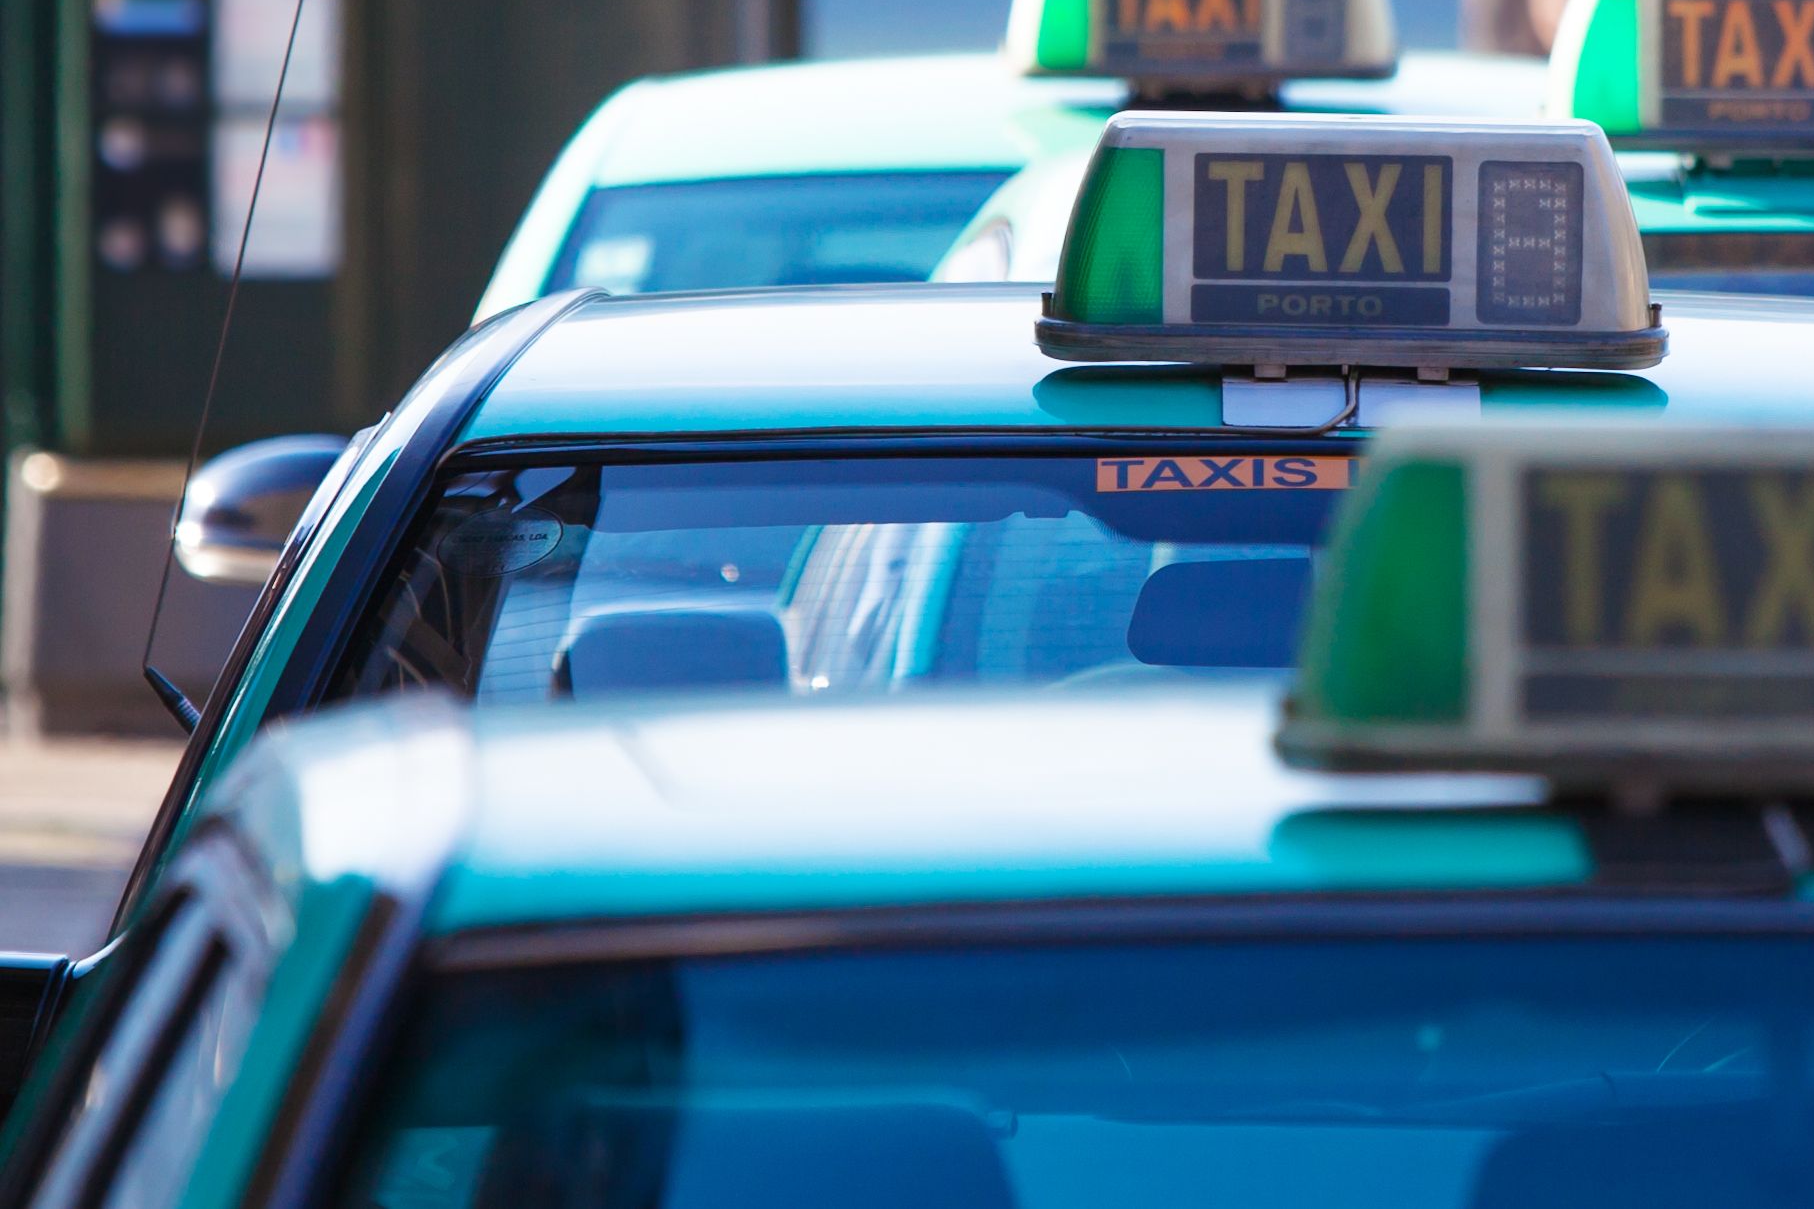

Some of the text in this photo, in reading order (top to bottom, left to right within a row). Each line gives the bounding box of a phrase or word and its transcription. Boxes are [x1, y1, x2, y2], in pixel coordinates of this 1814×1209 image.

[1208, 160, 1444, 274] TAXI
[1256, 293, 1383, 318] PORTO
[1100, 457, 1319, 489] TAXIS
